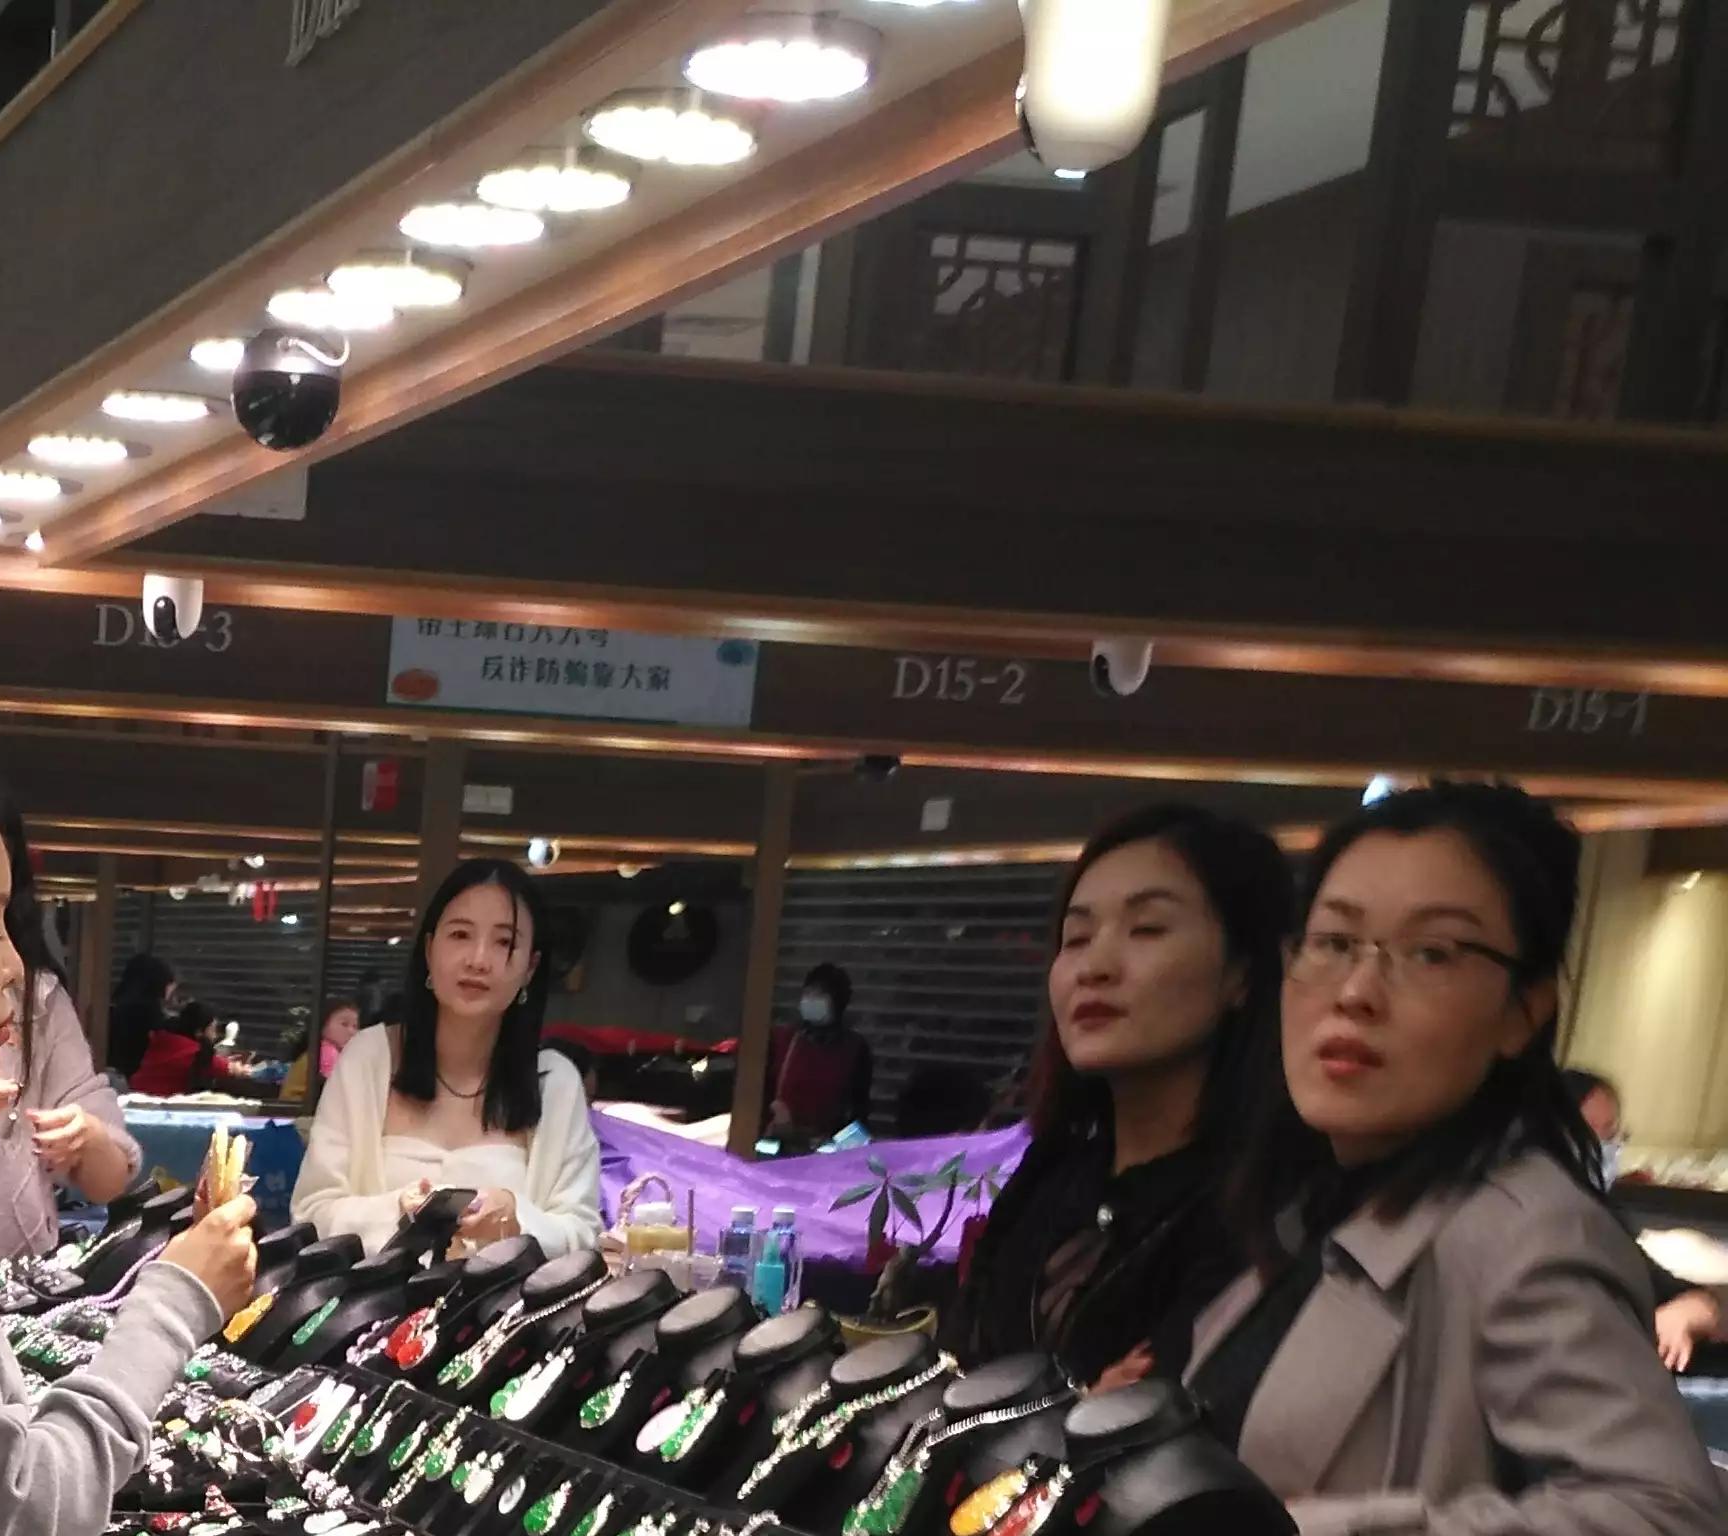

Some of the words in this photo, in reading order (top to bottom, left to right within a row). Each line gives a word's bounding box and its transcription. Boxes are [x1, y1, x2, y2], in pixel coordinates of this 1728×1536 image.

[93, 603, 234, 652] D-3
[481, 655, 670, 692] 反诈防骗靠大家
[893, 656, 1027, 704] D15-2
